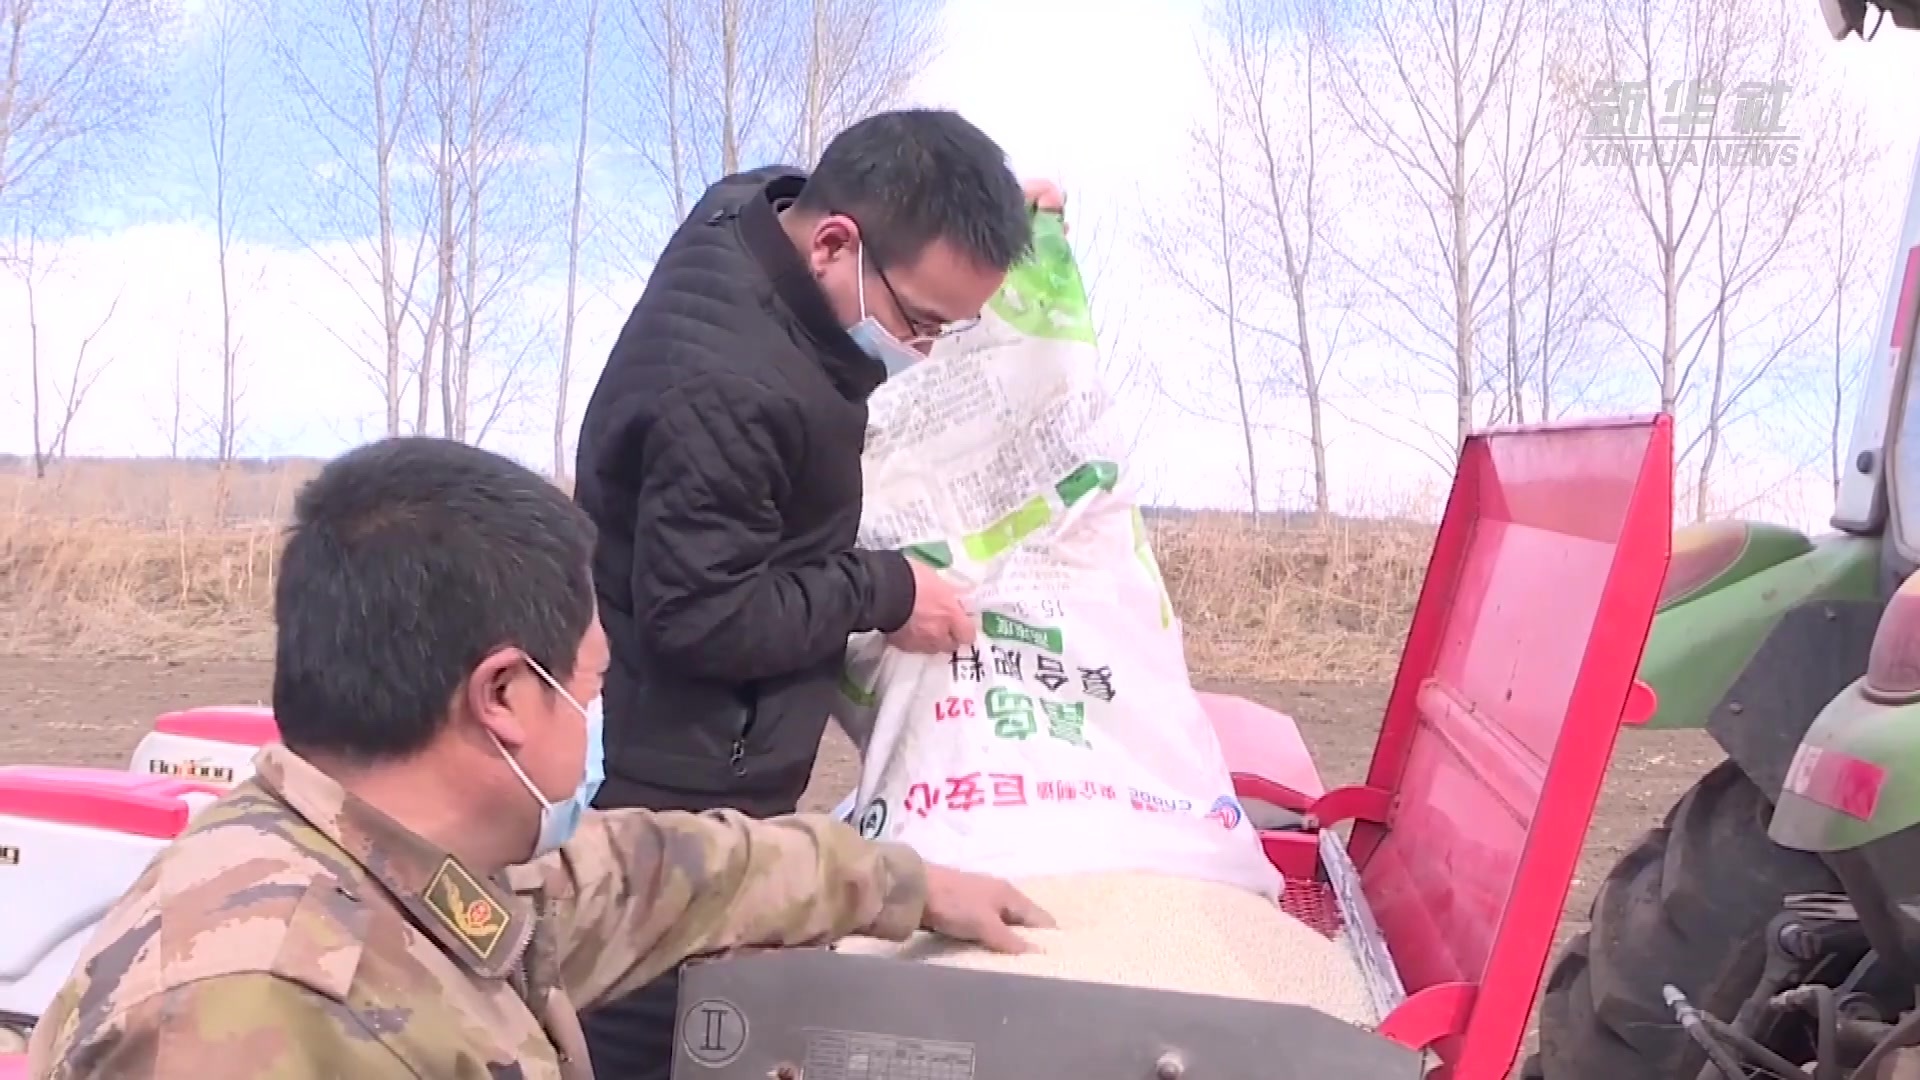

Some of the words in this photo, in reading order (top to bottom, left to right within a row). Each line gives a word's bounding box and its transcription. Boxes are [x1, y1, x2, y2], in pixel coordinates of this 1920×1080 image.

[949, 643, 1116, 702] 复合肥料
[935, 696, 975, 722] 321
[904, 771, 1027, 818] 巨安心
